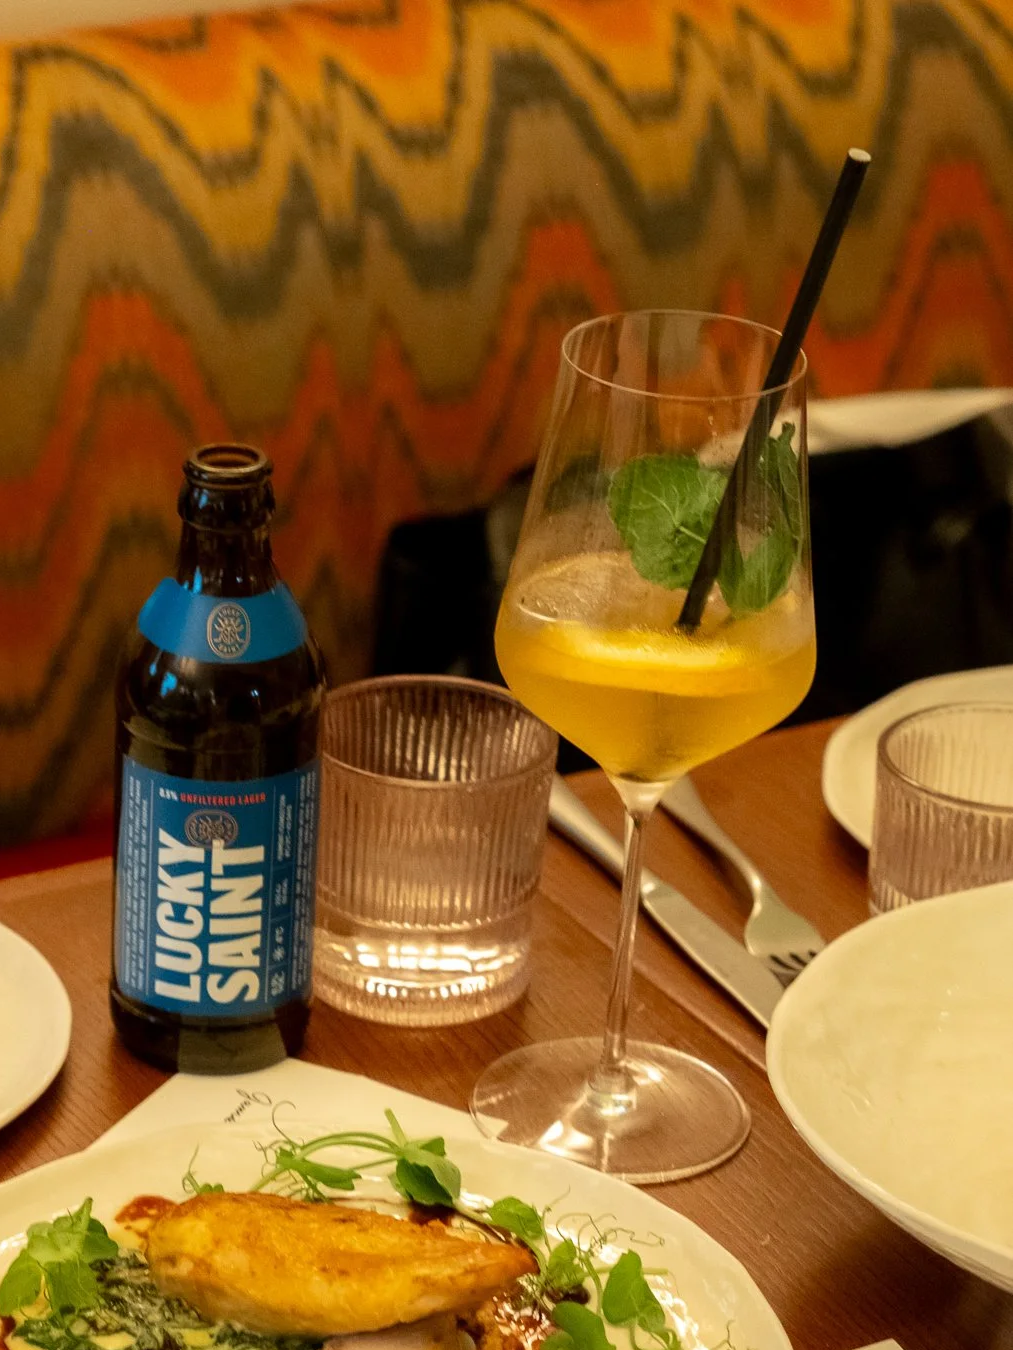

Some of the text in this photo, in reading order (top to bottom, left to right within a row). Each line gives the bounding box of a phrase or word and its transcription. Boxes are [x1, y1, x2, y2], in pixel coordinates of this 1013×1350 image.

[179, 792, 236, 807] UNFILTERED
[238, 792, 267, 806] LAGER
[154, 828, 205, 1003] LUCKY
[206, 838, 265, 1004] SAINT
